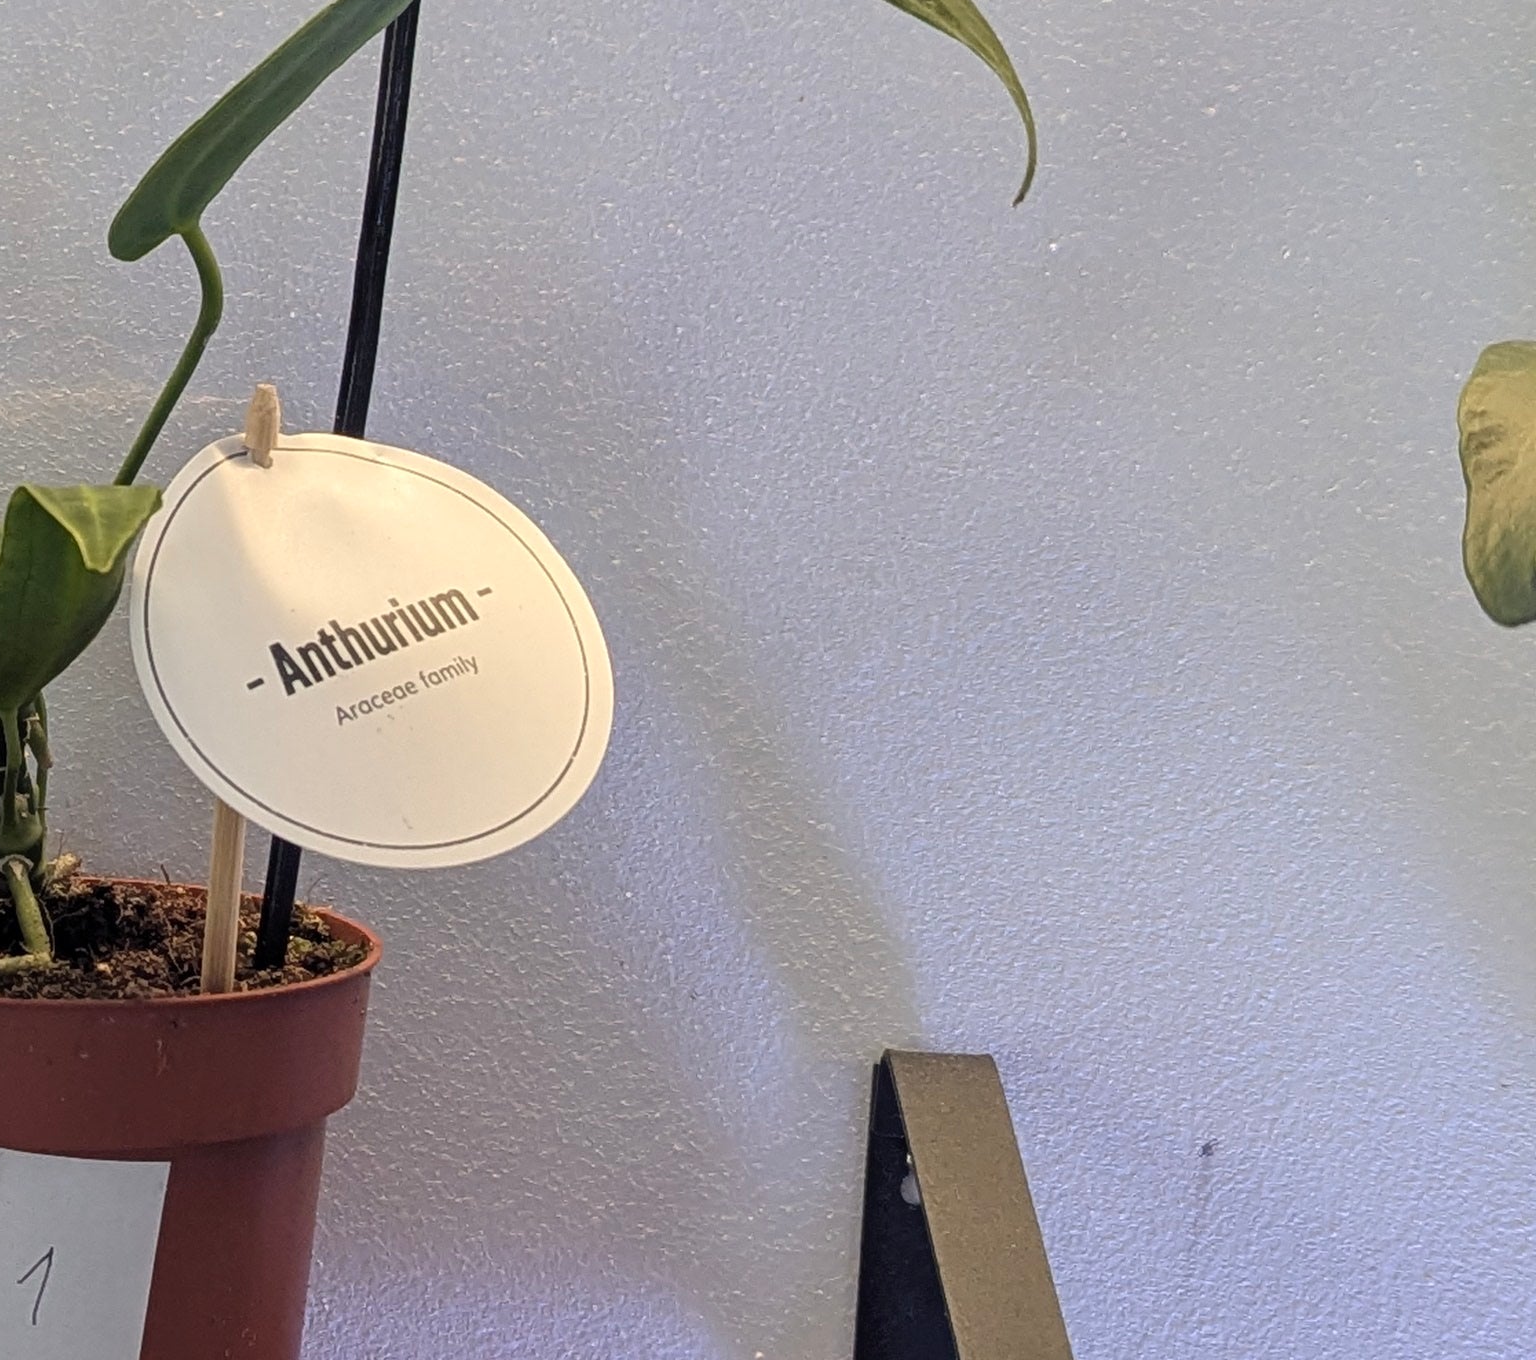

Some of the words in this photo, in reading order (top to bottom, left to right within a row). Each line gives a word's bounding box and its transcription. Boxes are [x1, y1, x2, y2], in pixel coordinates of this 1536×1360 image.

[335, 678, 419, 726] Araceae
[418, 655, 479, 689] family
[16, 1246, 54, 1326] 1
